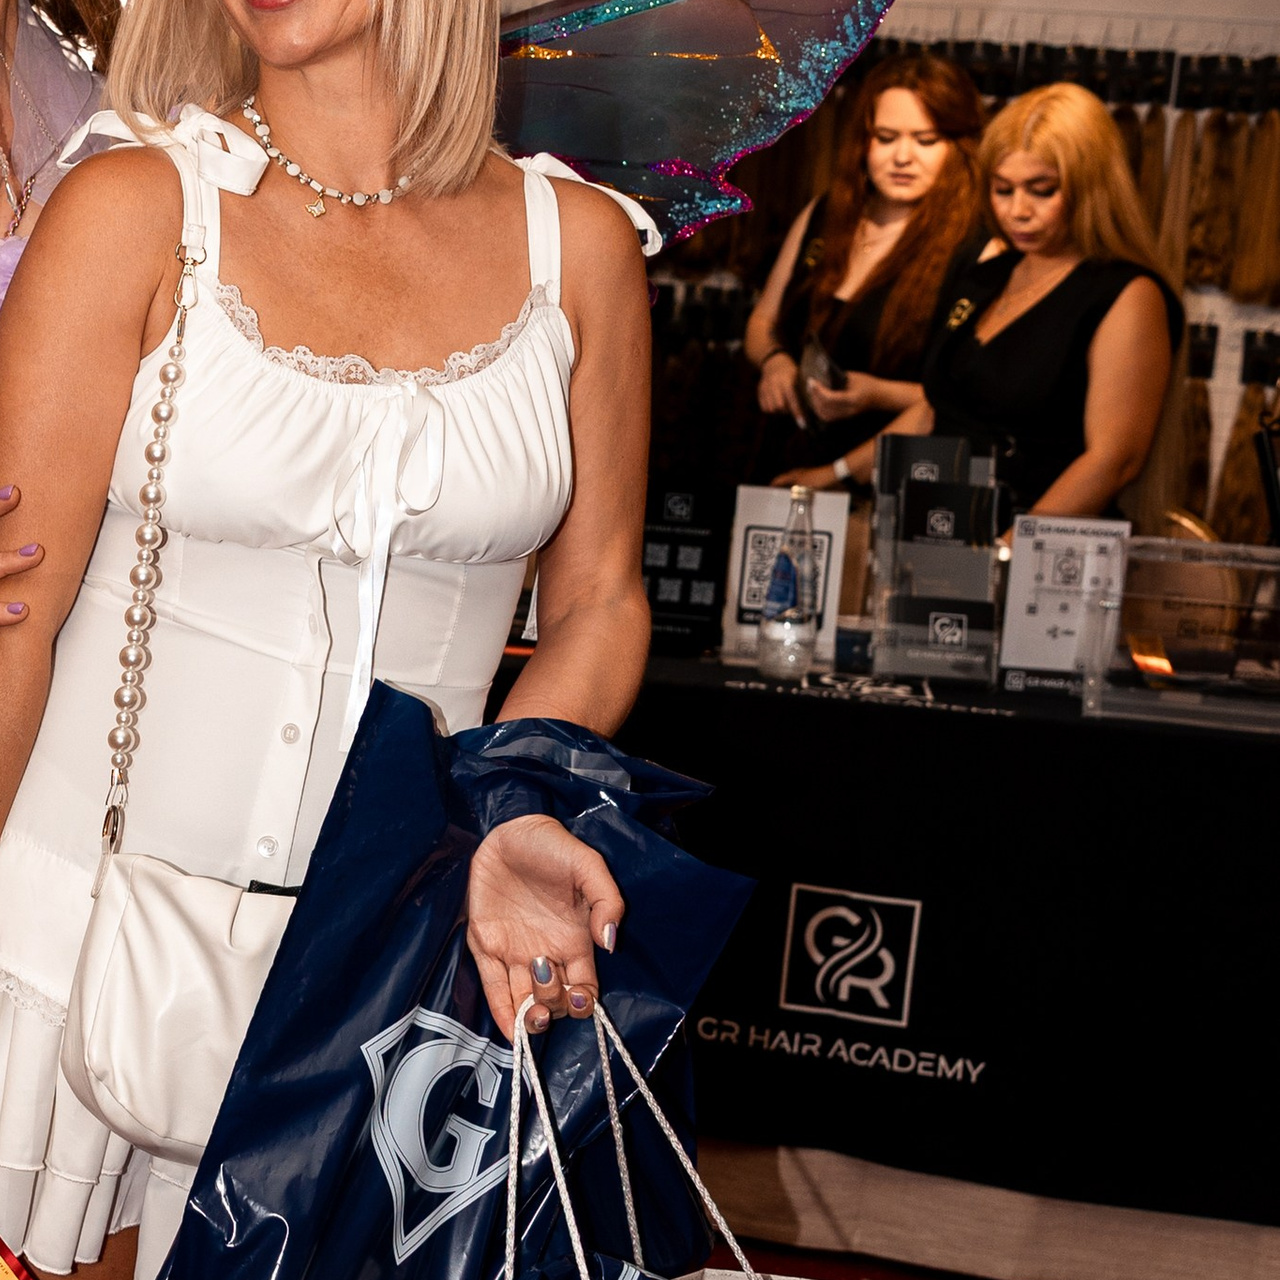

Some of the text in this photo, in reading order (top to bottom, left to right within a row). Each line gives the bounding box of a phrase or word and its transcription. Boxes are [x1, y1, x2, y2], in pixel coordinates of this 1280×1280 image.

[697, 1017, 986, 1084] GR HAIR ACADEMY
